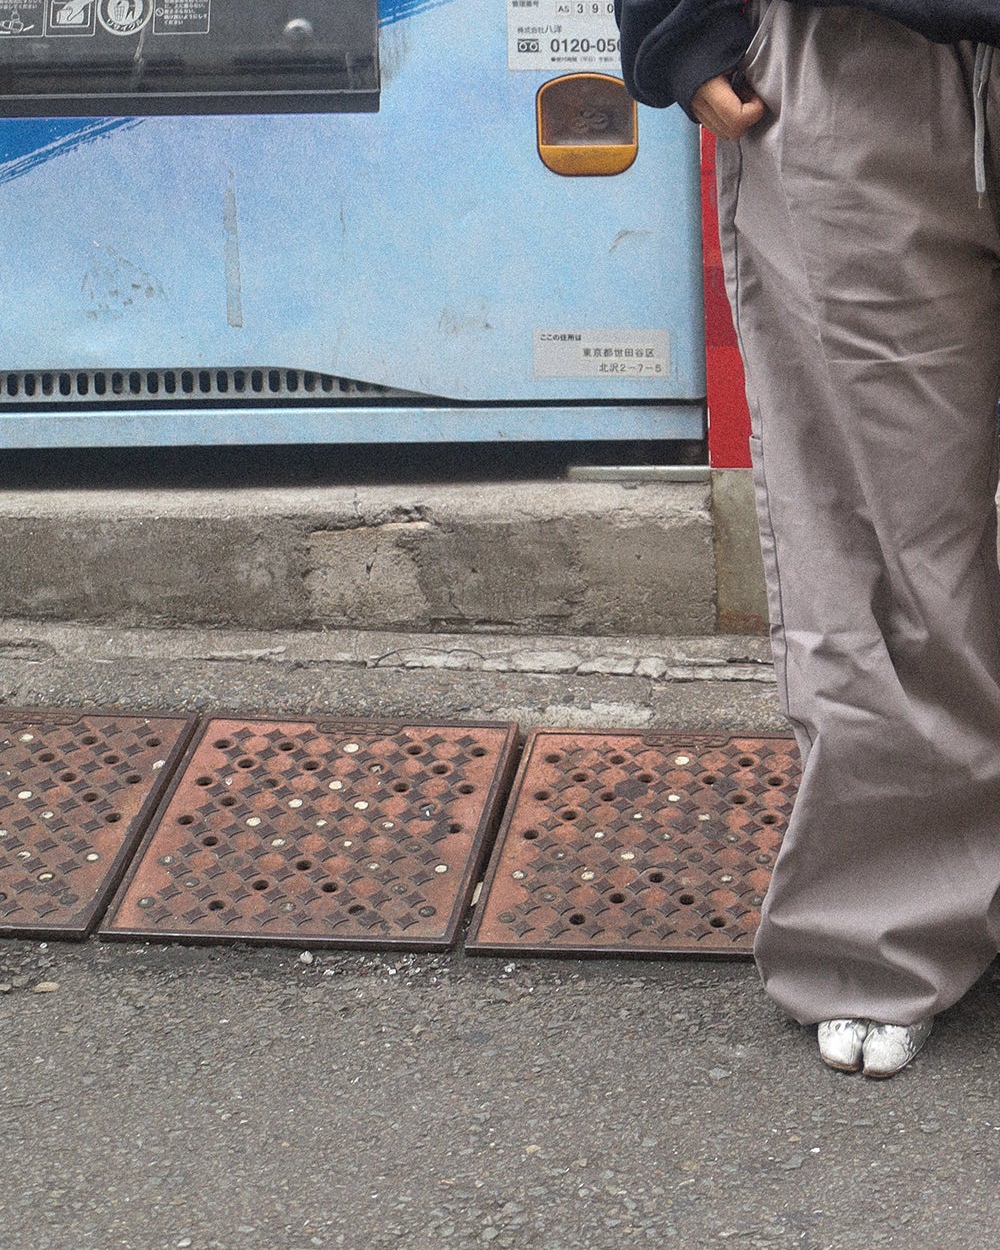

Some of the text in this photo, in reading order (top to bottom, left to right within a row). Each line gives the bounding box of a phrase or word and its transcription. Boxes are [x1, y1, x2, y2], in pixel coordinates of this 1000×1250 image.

[540, 333, 582, 342] ここの住所は
[582, 347, 656, 358] 東京都世田谷区
